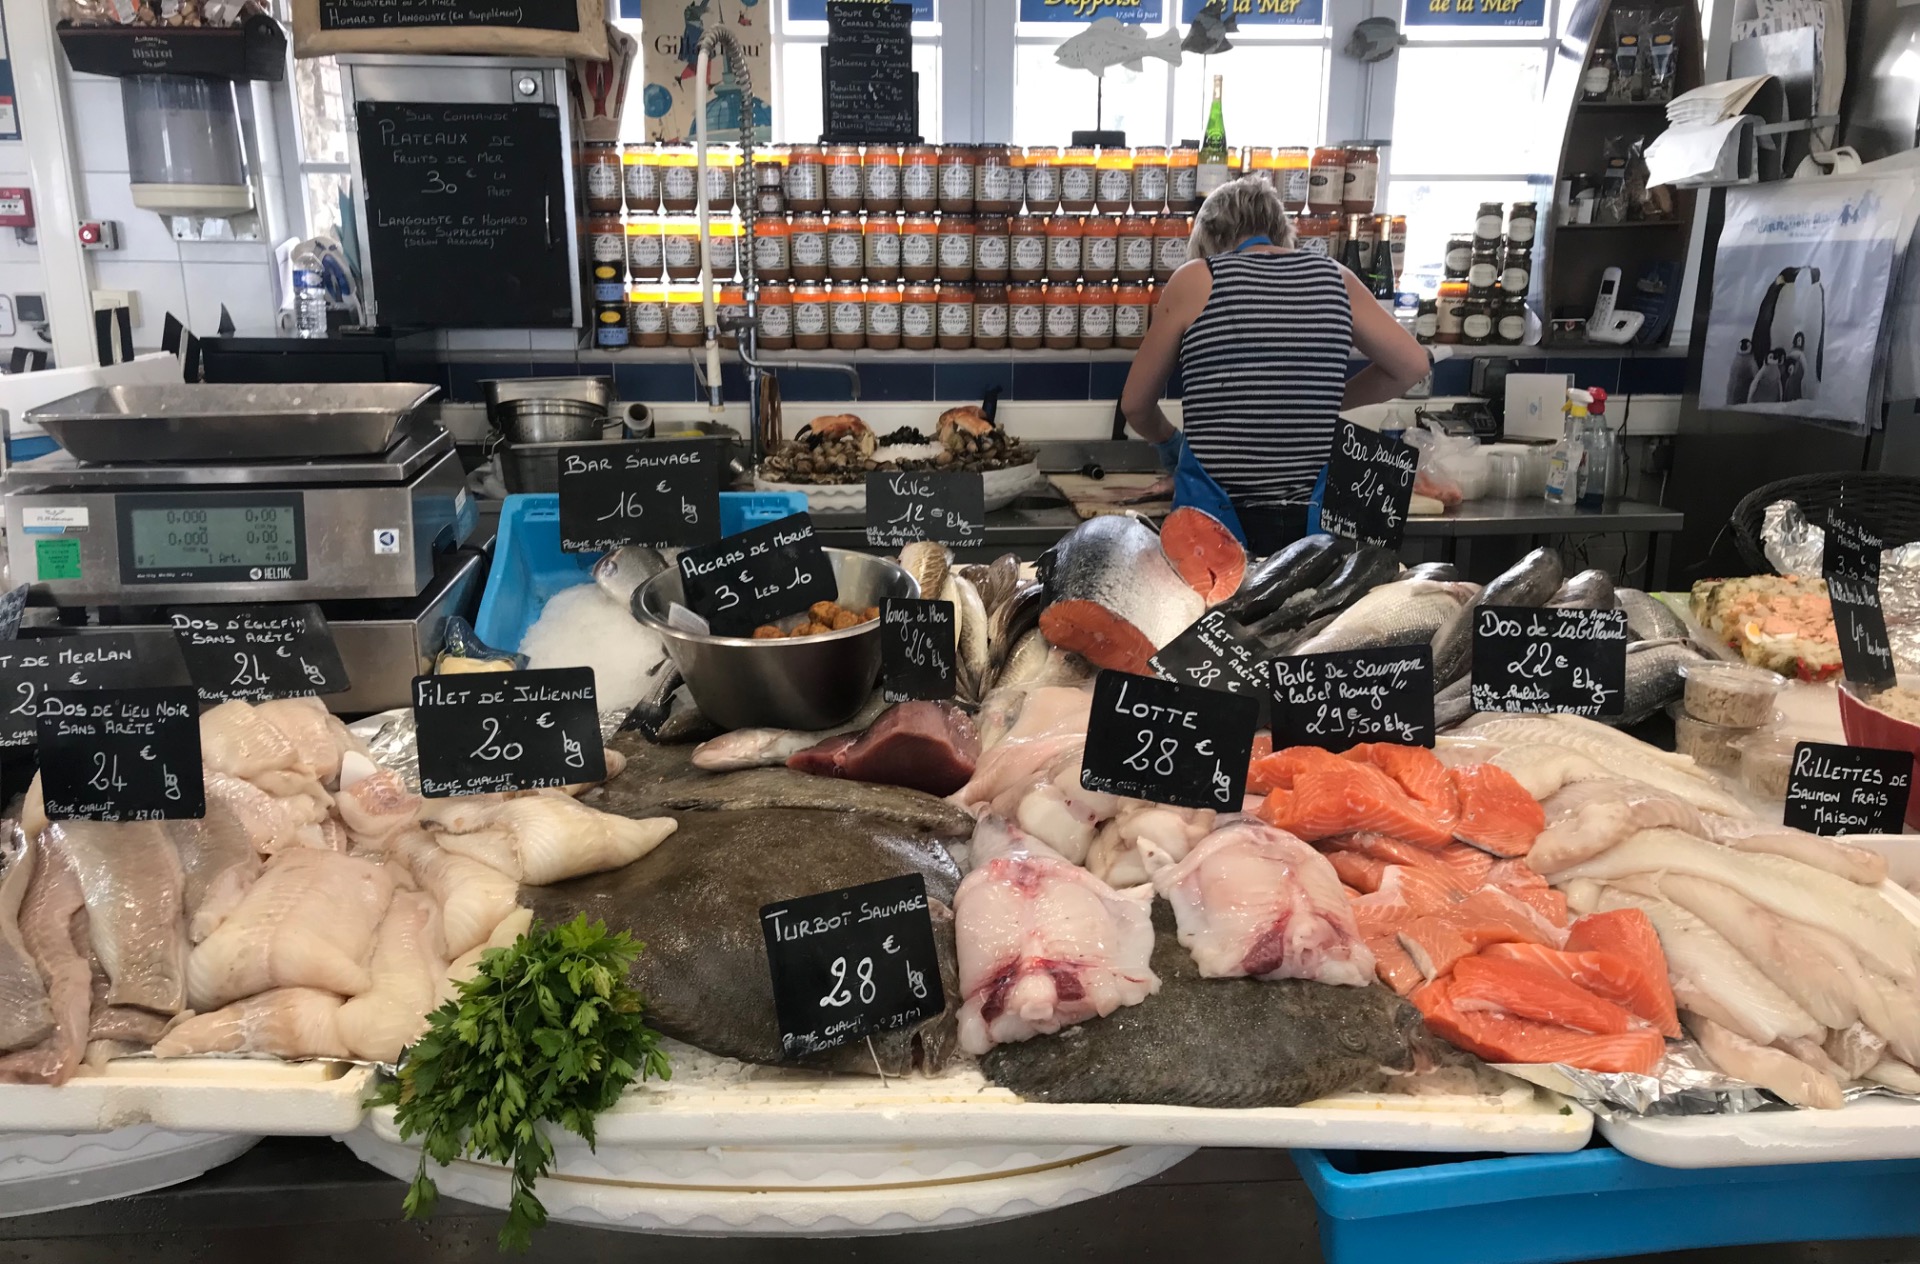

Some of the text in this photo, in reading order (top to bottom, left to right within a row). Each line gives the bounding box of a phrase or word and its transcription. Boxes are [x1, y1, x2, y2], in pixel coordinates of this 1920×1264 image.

[379, 119, 468, 146] PLATEAUX
[421, 170, 457, 193] 30
[564, 452, 701, 475] BAR SAUVAGE
[597, 480, 698, 524] 16 € kg
[887, 502, 924, 524] 12
[167, 508, 277, 524] 0,000 0,00
[168, 531, 278, 546] 0,000 0,00
[681, 550, 745, 578] ACCRAS
[750, 542, 769, 557] DE
[715, 570, 754, 611] 3 €
[754, 567, 812, 600] LES 10
[171, 613, 219, 630] DOS
[1527, 613, 1549, 637] de
[20, 656, 49, 668] DE
[59, 648, 132, 665] MERLAN
[905, 628, 926, 666] 26
[1230, 645, 1252, 662] DE
[1507, 642, 1552, 678] 22
[1555, 655, 1569, 668] €
[69, 671, 87, 685] €
[230, 646, 326, 685] 24 € kg
[1185, 660, 1221, 687] 28
[37, 698, 87, 717] DOS
[91, 704, 112, 717] DE
[478, 691, 505, 704] DE
[1115, 680, 1199, 729] LOTTE
[470, 712, 585, 768] 20 € kg
[88, 745, 181, 800] 24 € kg
[1122, 730, 1231, 803] 28 € kg
[1788, 782, 1840, 802] SAUMON
[1889, 775, 1908, 786] DE
[765, 895, 927, 942] TURBOT SAUVAGE
[819, 935, 928, 1007] 28 € kg
